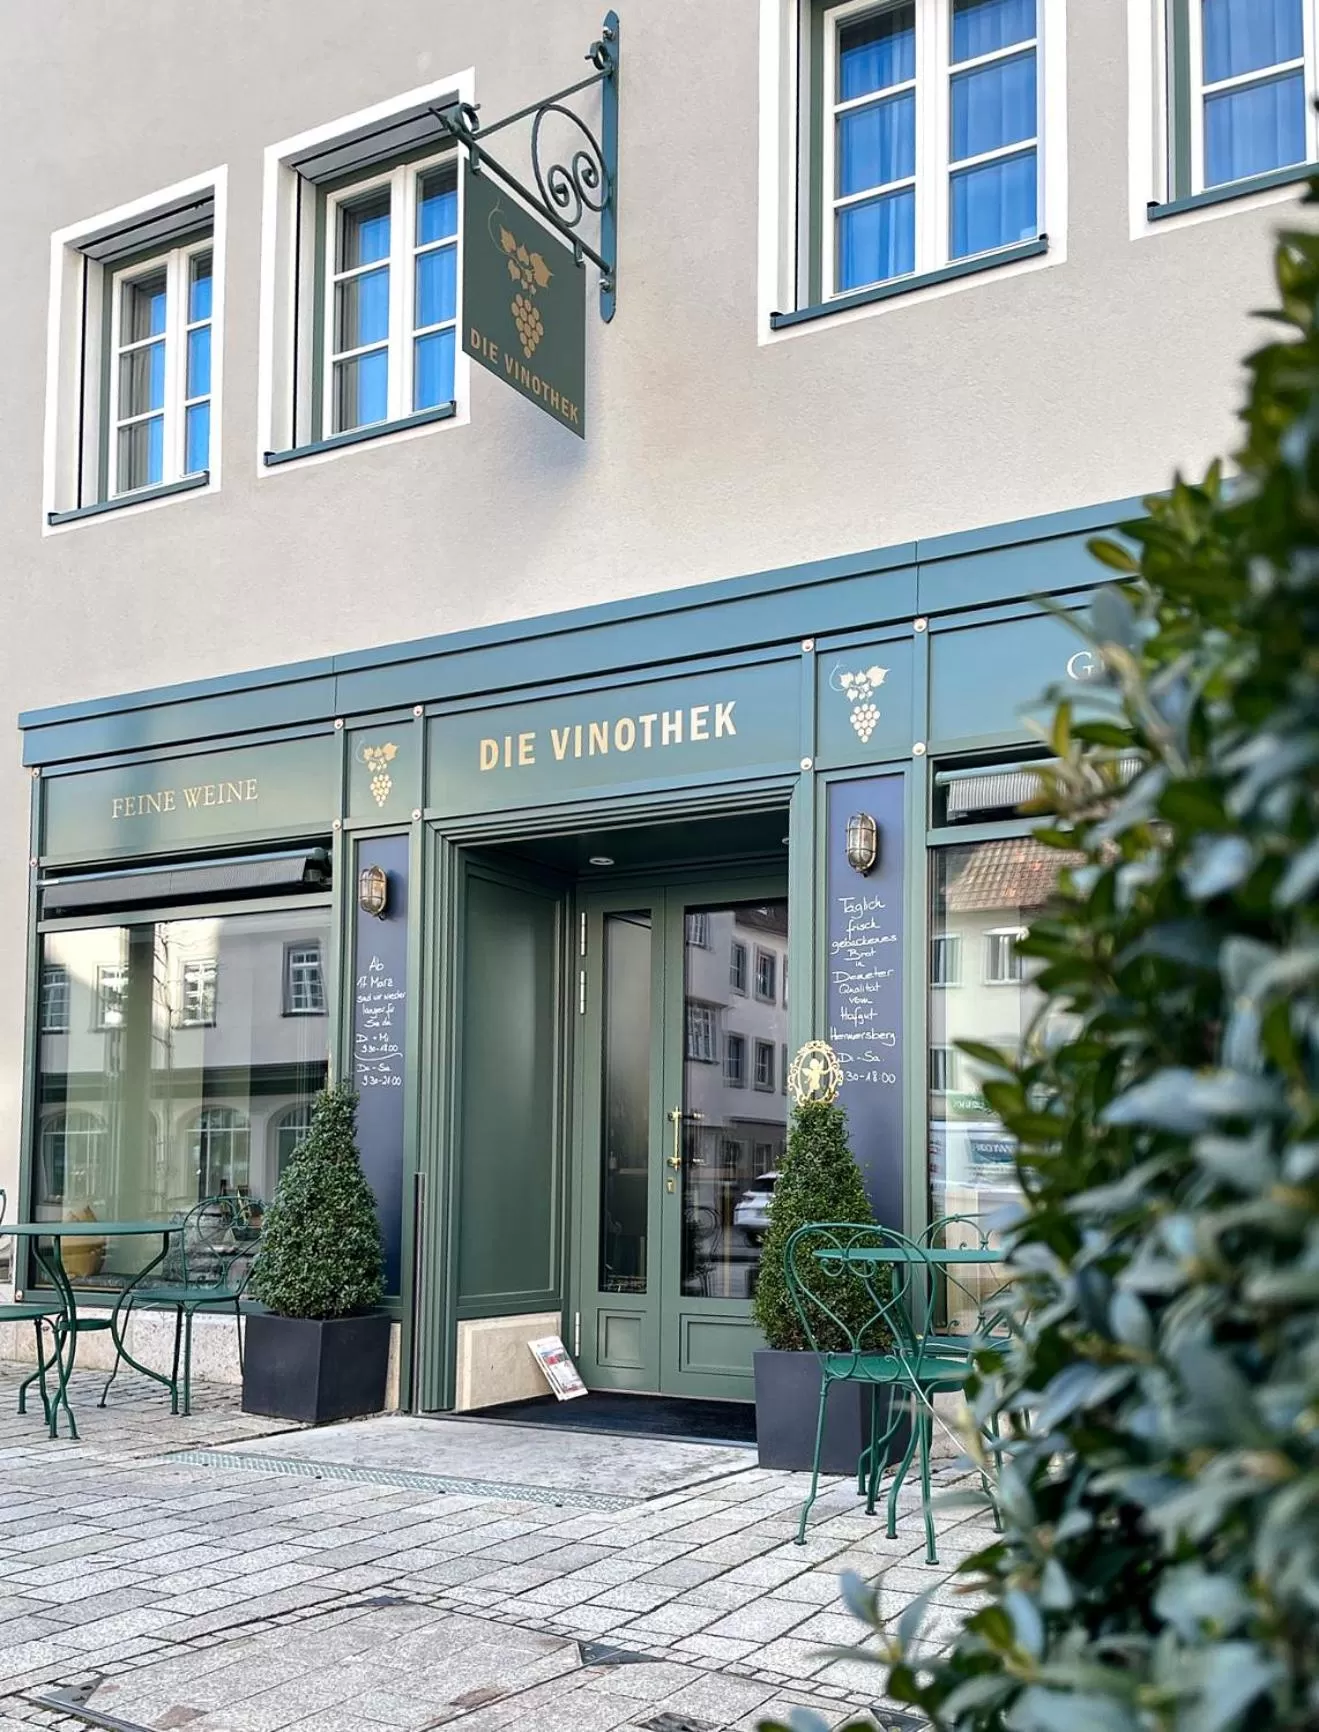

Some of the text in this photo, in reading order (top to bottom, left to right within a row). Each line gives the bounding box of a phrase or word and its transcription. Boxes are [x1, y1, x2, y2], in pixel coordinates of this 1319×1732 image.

[471, 328, 578, 424] DIE VINOTHEK
[480, 701, 736, 771] DIE VINOTHEK
[112, 779, 259, 818] FEINE WEINE
[844, 947, 876, 960] Brot
